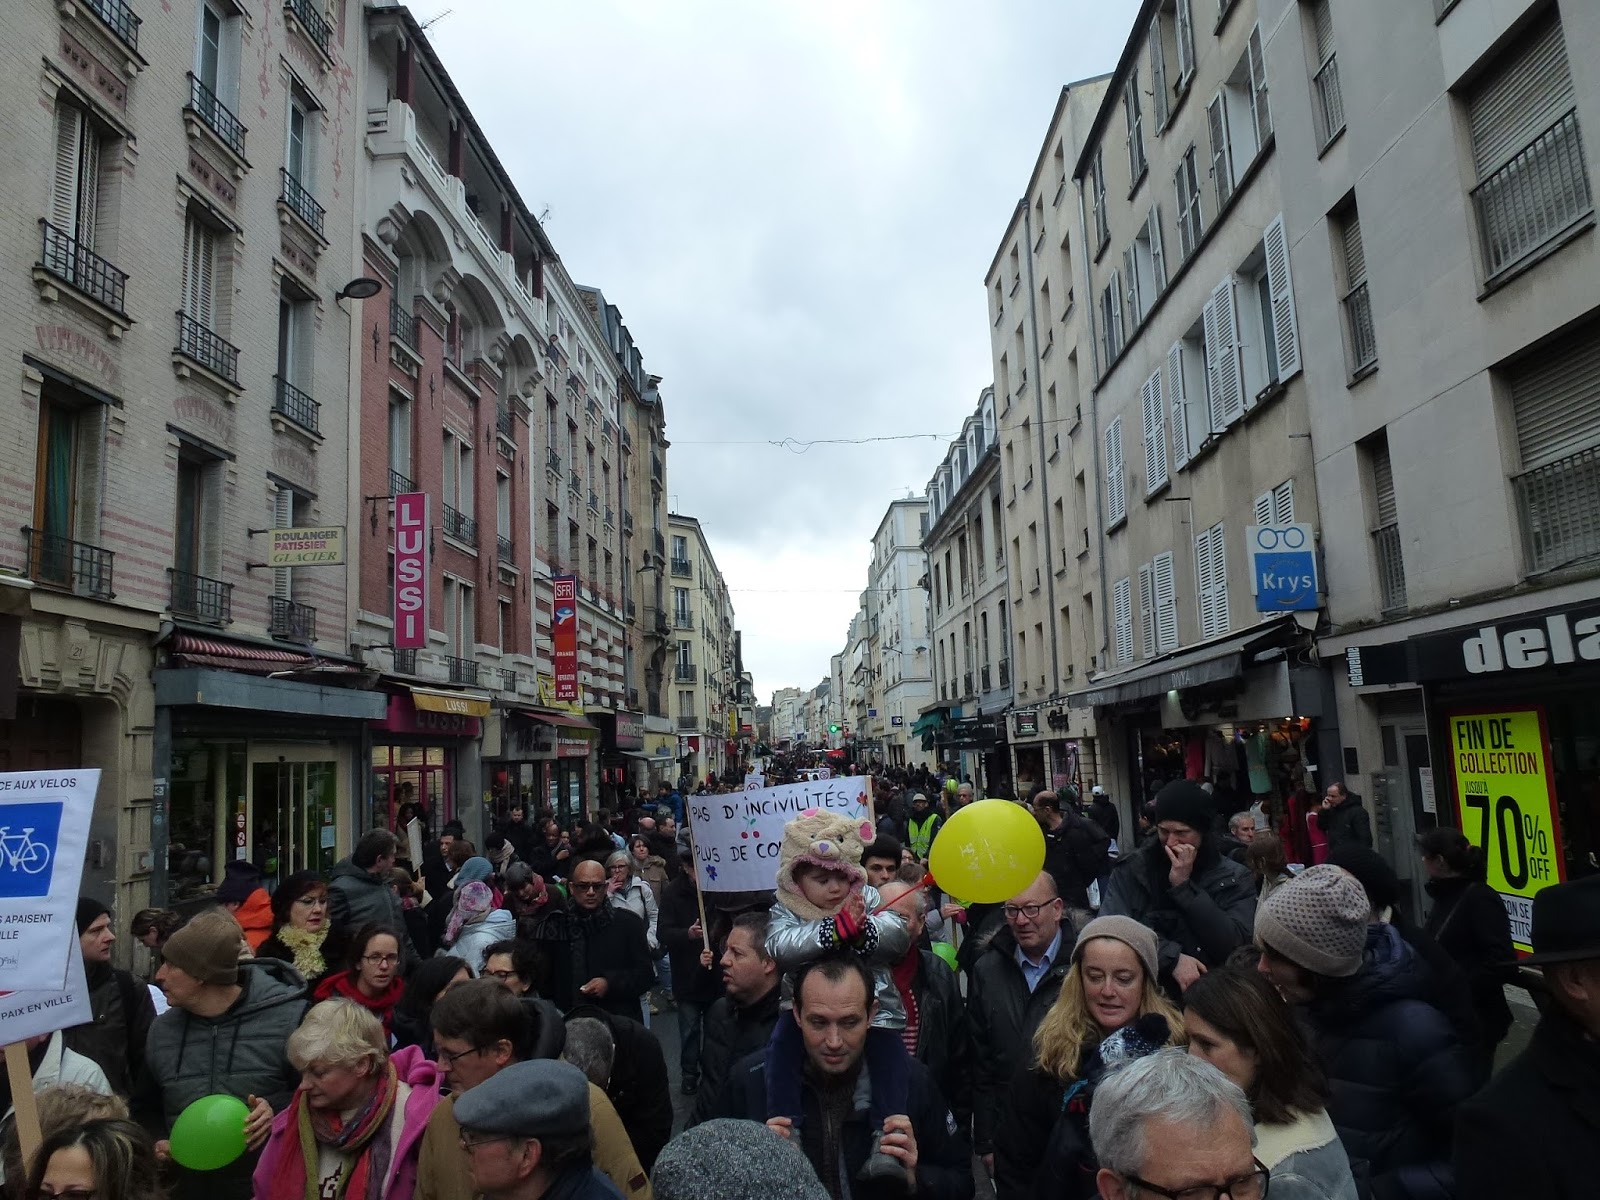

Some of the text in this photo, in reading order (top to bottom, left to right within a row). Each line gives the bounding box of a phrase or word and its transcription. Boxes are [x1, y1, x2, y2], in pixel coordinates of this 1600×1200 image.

[274, 530, 338, 541] BOULANGER
[274, 541, 327, 551] PATISSIER
[273, 551, 338, 563] GLACIER
[398, 503, 423, 639] LUSSI
[1262, 572, 1312, 594] Krys
[556, 585, 572, 597] SFR
[73, 647, 83, 657] 21
[1346, 647, 1364, 686] delaveine
[445, 700, 468, 712] LUSSI
[1456, 718, 1514, 750] FIN DE
[1459, 752, 1539, 774] COLLECTION
[13, 780, 37, 790] AUX
[40, 778, 77, 788] VELOS
[691, 806, 711, 822] PAS
[695, 841, 782, 863] PLUS DE CO
[1529, 857, 1550, 881] OFF
[4, 914, 53, 924] APAISENT
[0, 930, 19, 940] LLE
[1, 994, 74, 1020] PAIX EN VILLE
